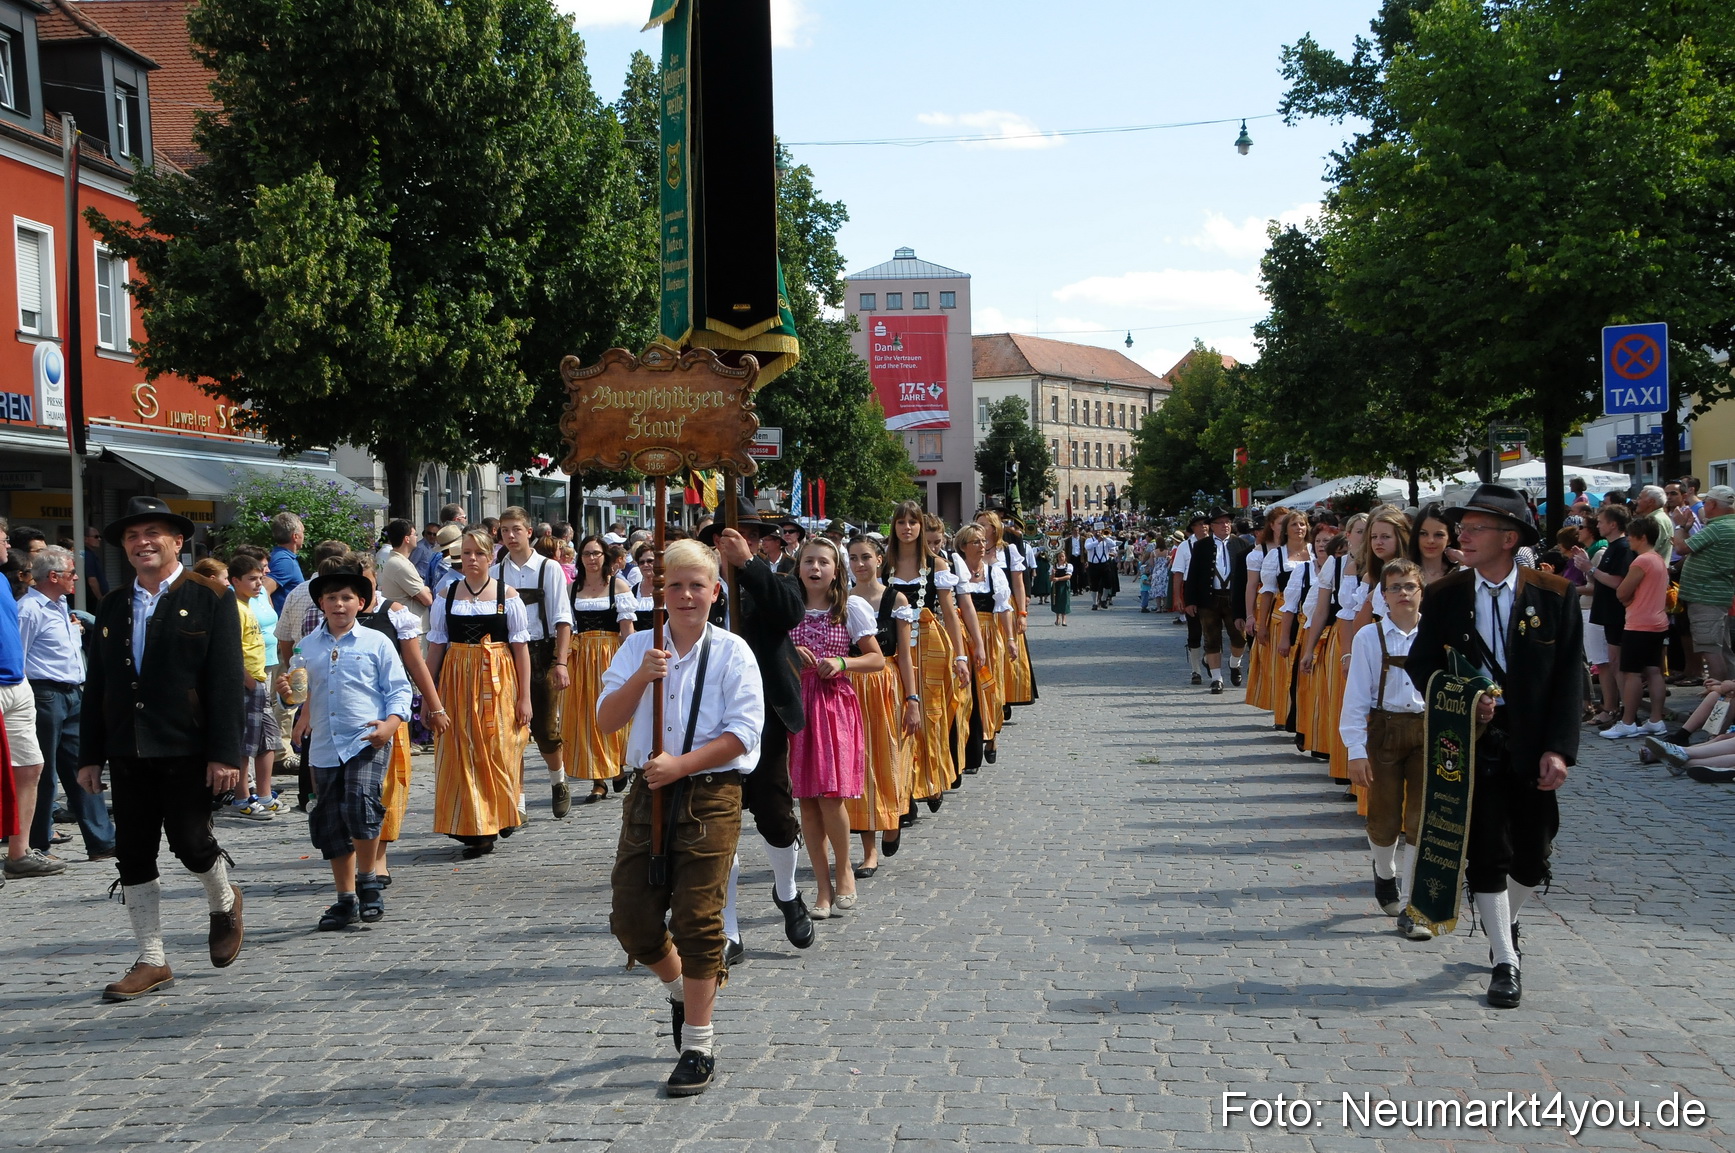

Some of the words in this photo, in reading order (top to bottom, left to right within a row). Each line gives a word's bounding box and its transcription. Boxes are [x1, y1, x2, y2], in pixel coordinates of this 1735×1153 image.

[874, 343, 904, 352] Dane
[899, 382, 926, 394] 175
[1610, 386, 1662, 407] TAXI
[748, 447, 769, 455] ngasse
[41, 506, 73, 518] SCHLIE
[1434, 690, 1467, 715] Dank
[1422, 846, 1459, 871] Berngau
